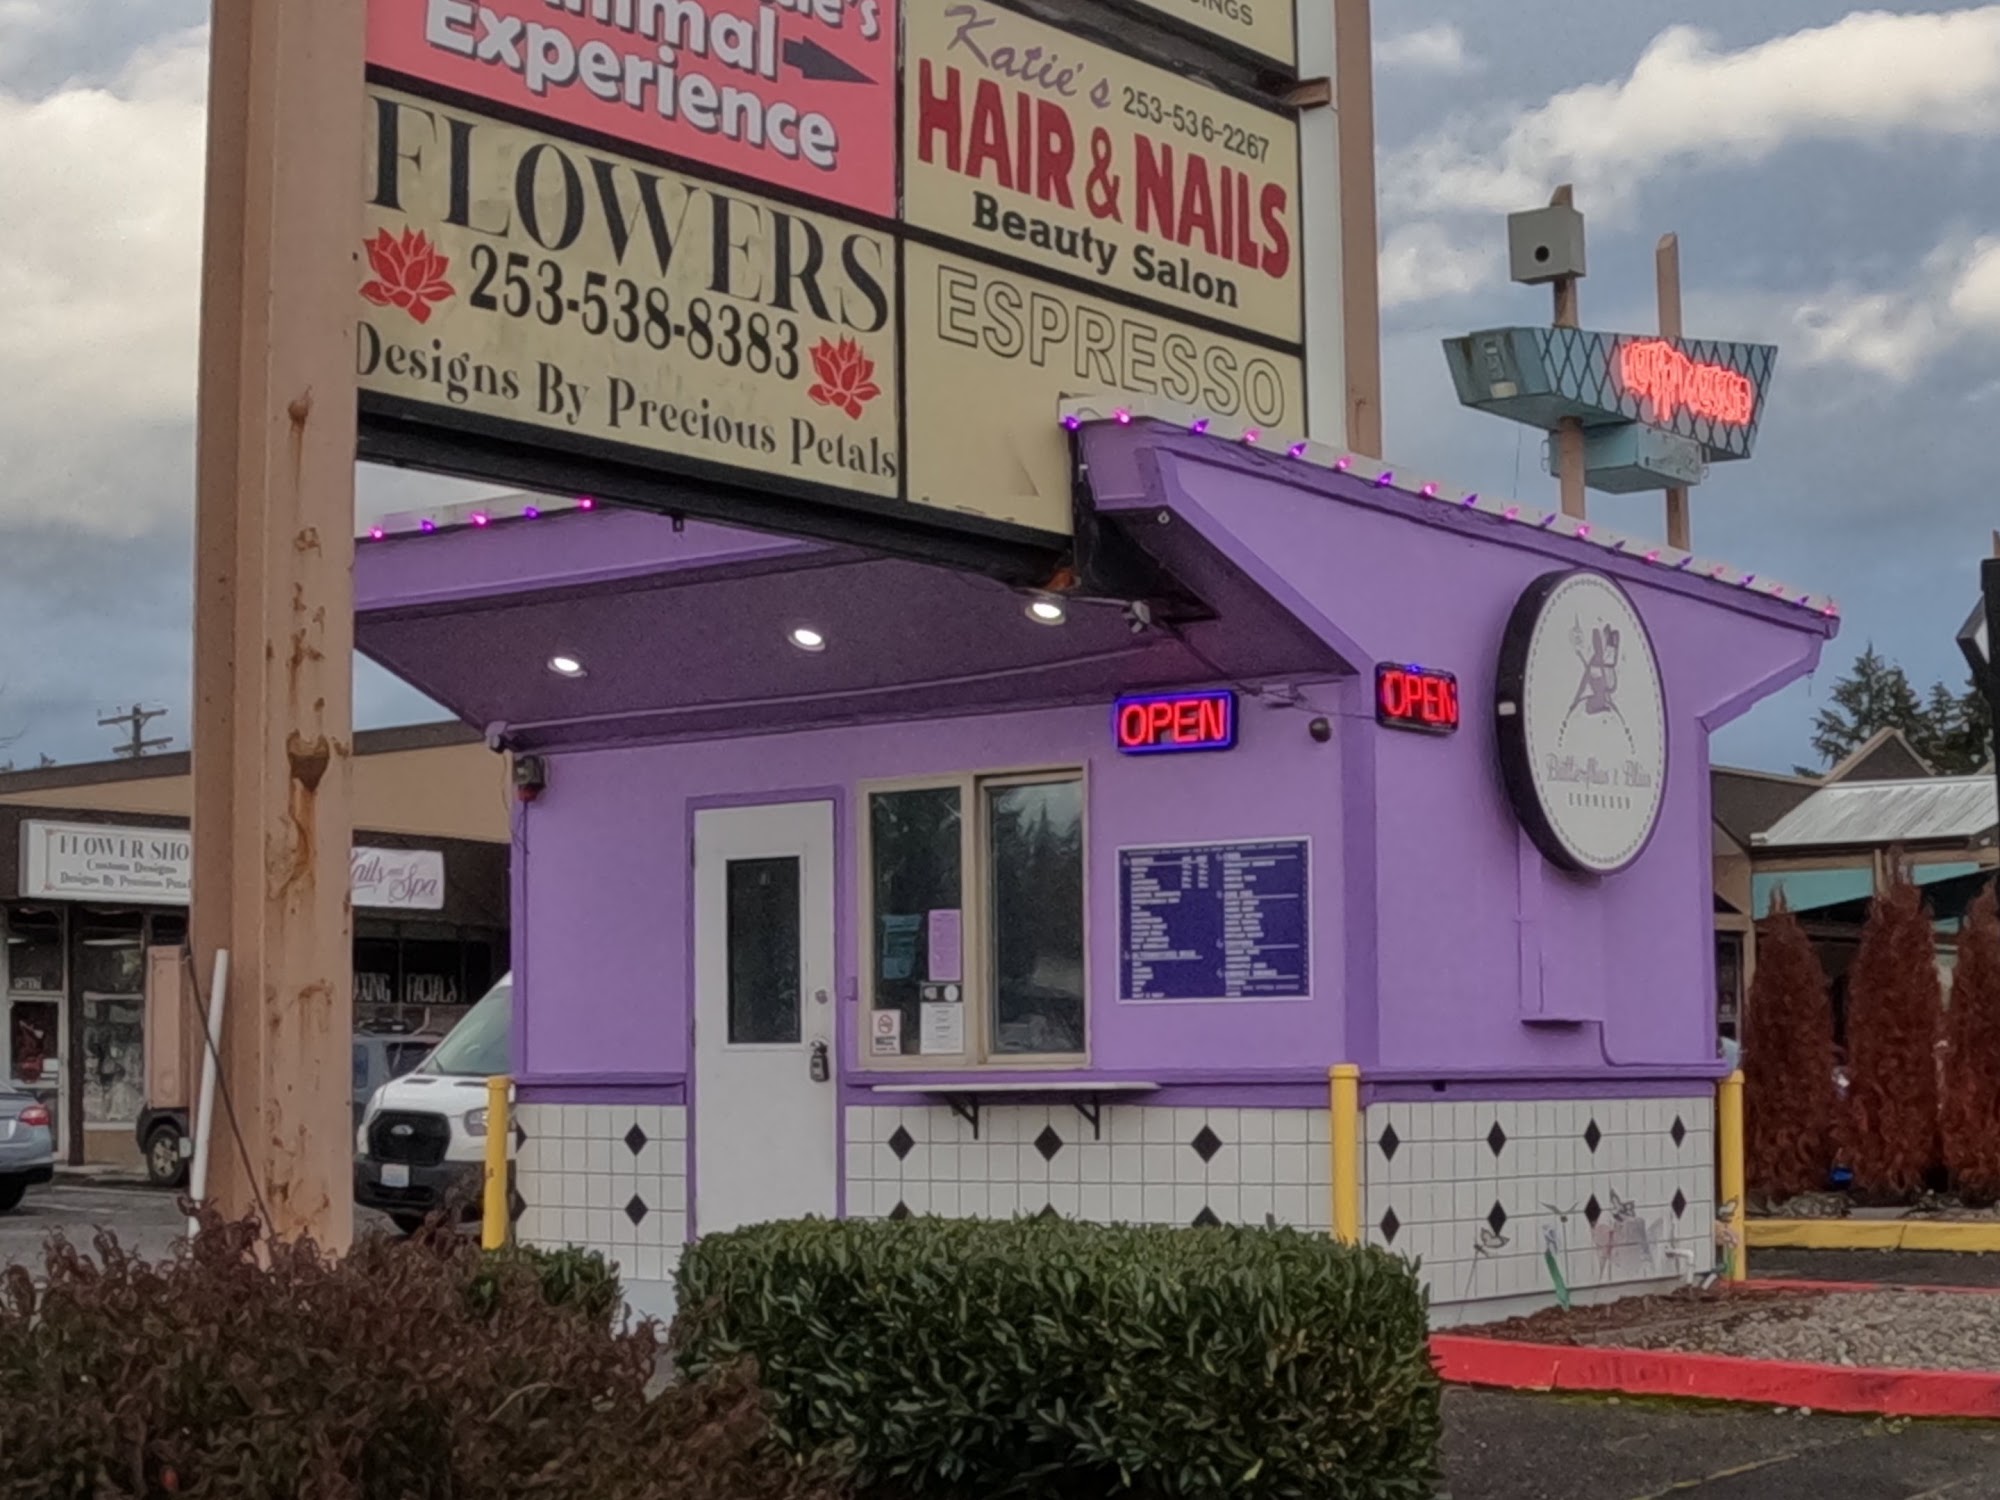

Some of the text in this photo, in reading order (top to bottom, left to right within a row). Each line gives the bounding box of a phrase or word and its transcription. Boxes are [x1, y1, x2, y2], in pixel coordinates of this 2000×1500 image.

[425, 0, 838, 168] Experience
[944, 4, 1111, 109] Katie's
[917, 58, 1290, 280] HAIR & NAILS
[1123, 86, 1270, 164] 253-536-2267
[366, 95, 889, 334] FLOWERS
[972, 190, 1239, 309] Beauty Salon
[469, 243, 800, 381] 253-538-8383
[937, 264, 1286, 428] ESPRESSO
[356, 320, 897, 480] Designs By Precious Petals
[1118, 698, 1227, 745] OPEN
[1382, 670, 1456, 724] OPEN
[60, 835, 190, 862] FLOWER SHO
